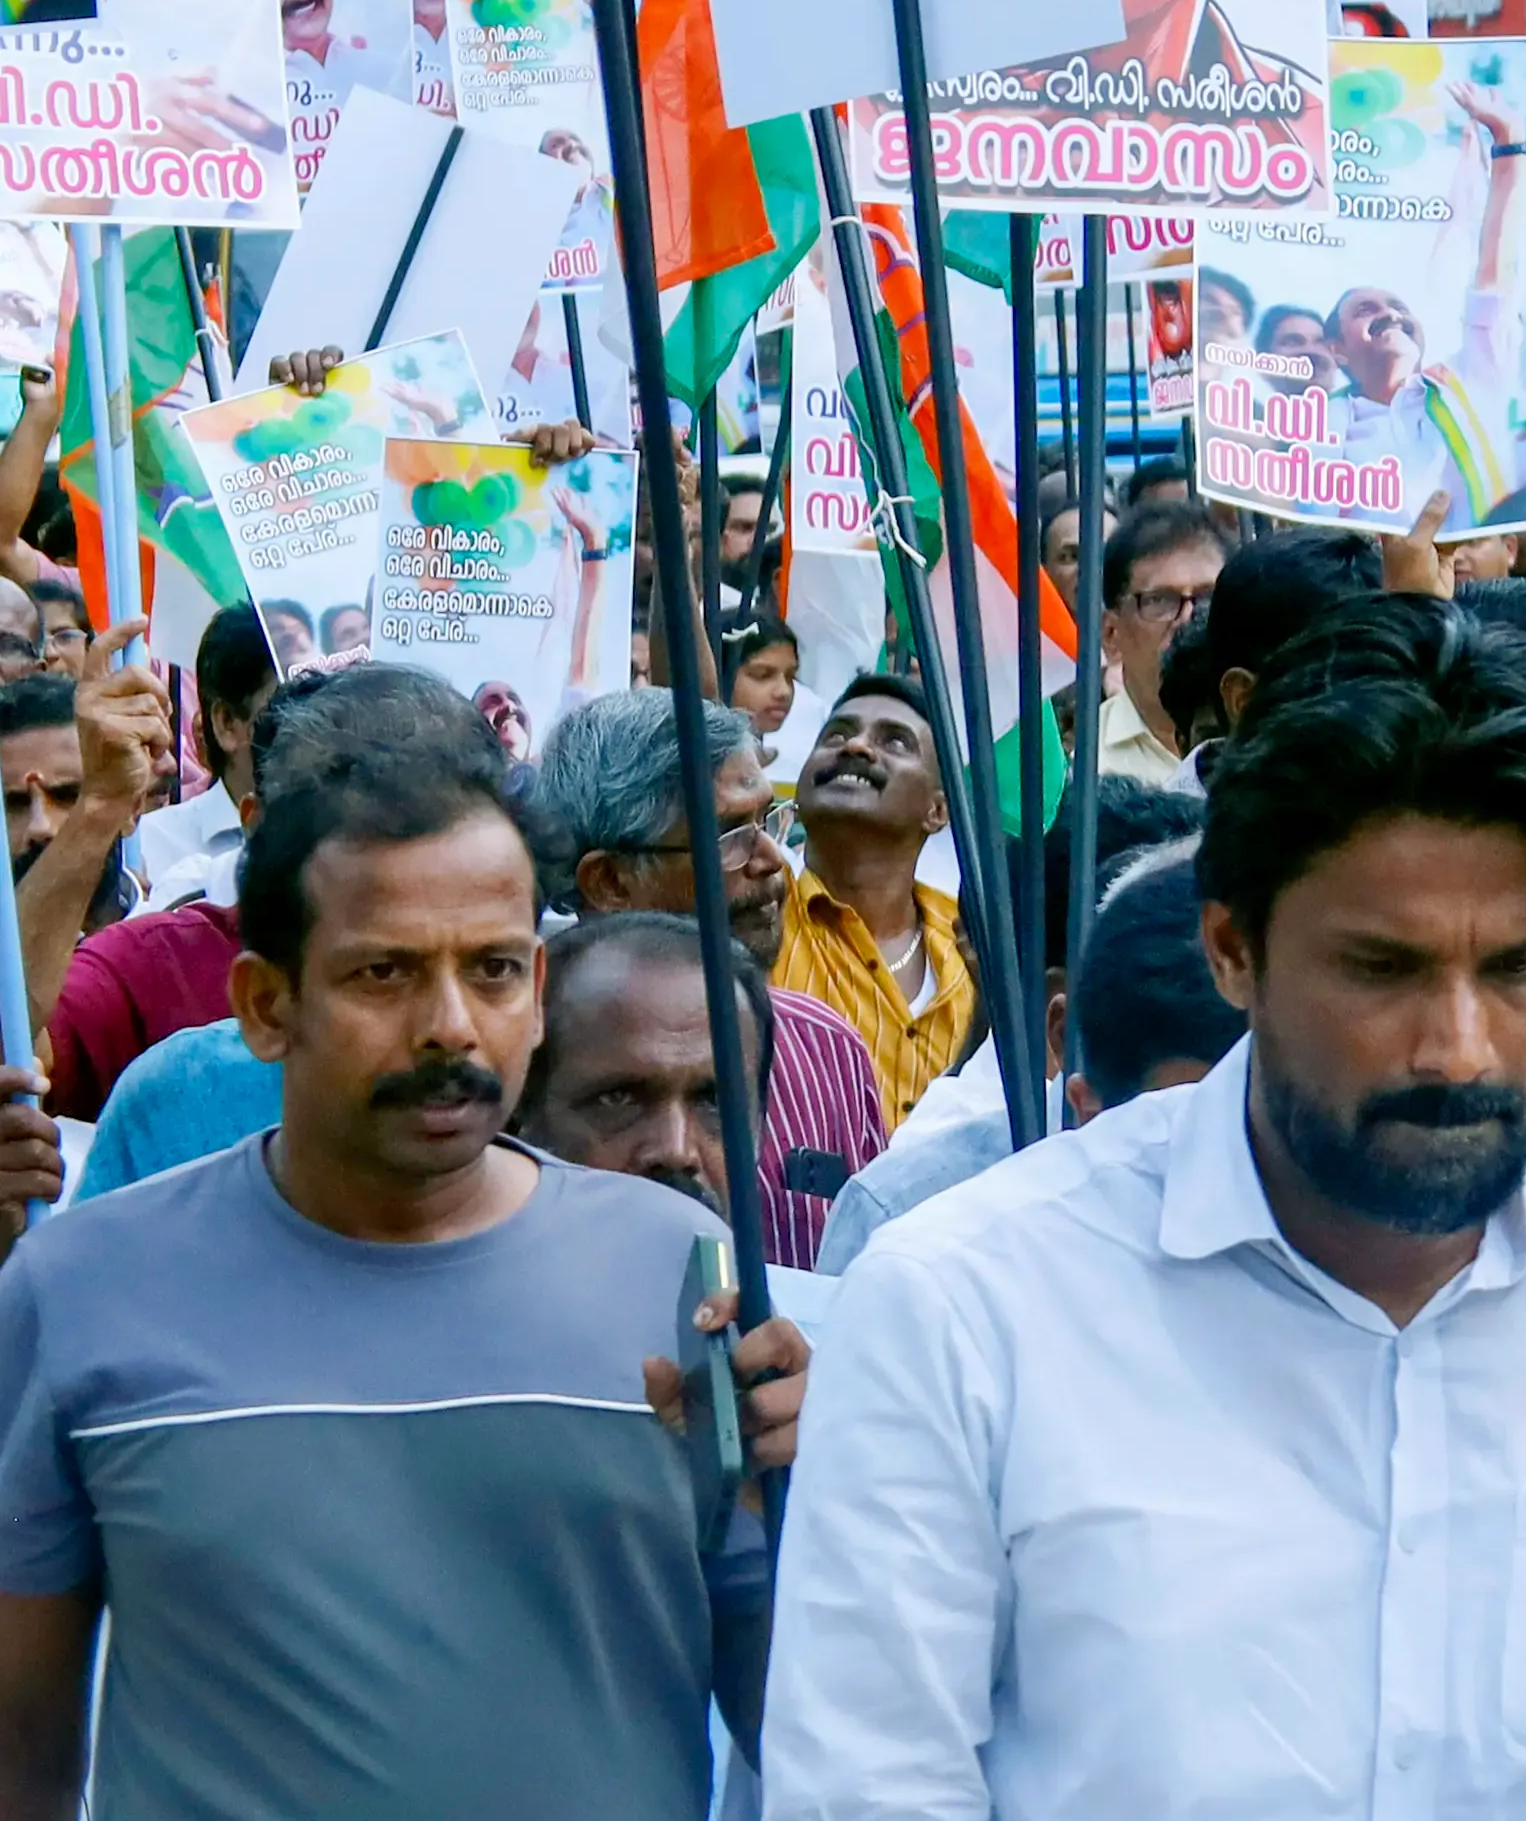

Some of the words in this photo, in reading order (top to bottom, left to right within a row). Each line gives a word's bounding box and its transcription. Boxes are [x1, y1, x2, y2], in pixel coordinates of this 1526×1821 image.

[1045, 55, 1150, 115] വി.ഡി.
[1156, 62, 1303, 120] സതീശൻ
[1205, 343, 1314, 379] നയിക്കാൻ
[1206, 376, 1341, 446] വി.ഡി.
[221, 460, 266, 494] ഒരേ
[267, 442, 354, 479] വികാരം,
[1206, 436, 1405, 515] സതീശൻ
[230, 489, 276, 517] ഒരേ
[280, 470, 369, 505] വിചാരം...
[248, 543, 286, 571] ഒറ്റ
[387, 524, 428, 551] ഒരേ
[429, 522, 507, 557] വികാരം,
[385, 555, 426, 579] ഒരേ
[428, 553, 512, 584] വിചാരം...
[382, 588, 555, 623] കേരളമൊന്നാകെ
[380, 617, 412, 646] ഒറ്റ
[415, 615, 480, 645] പേര്...
